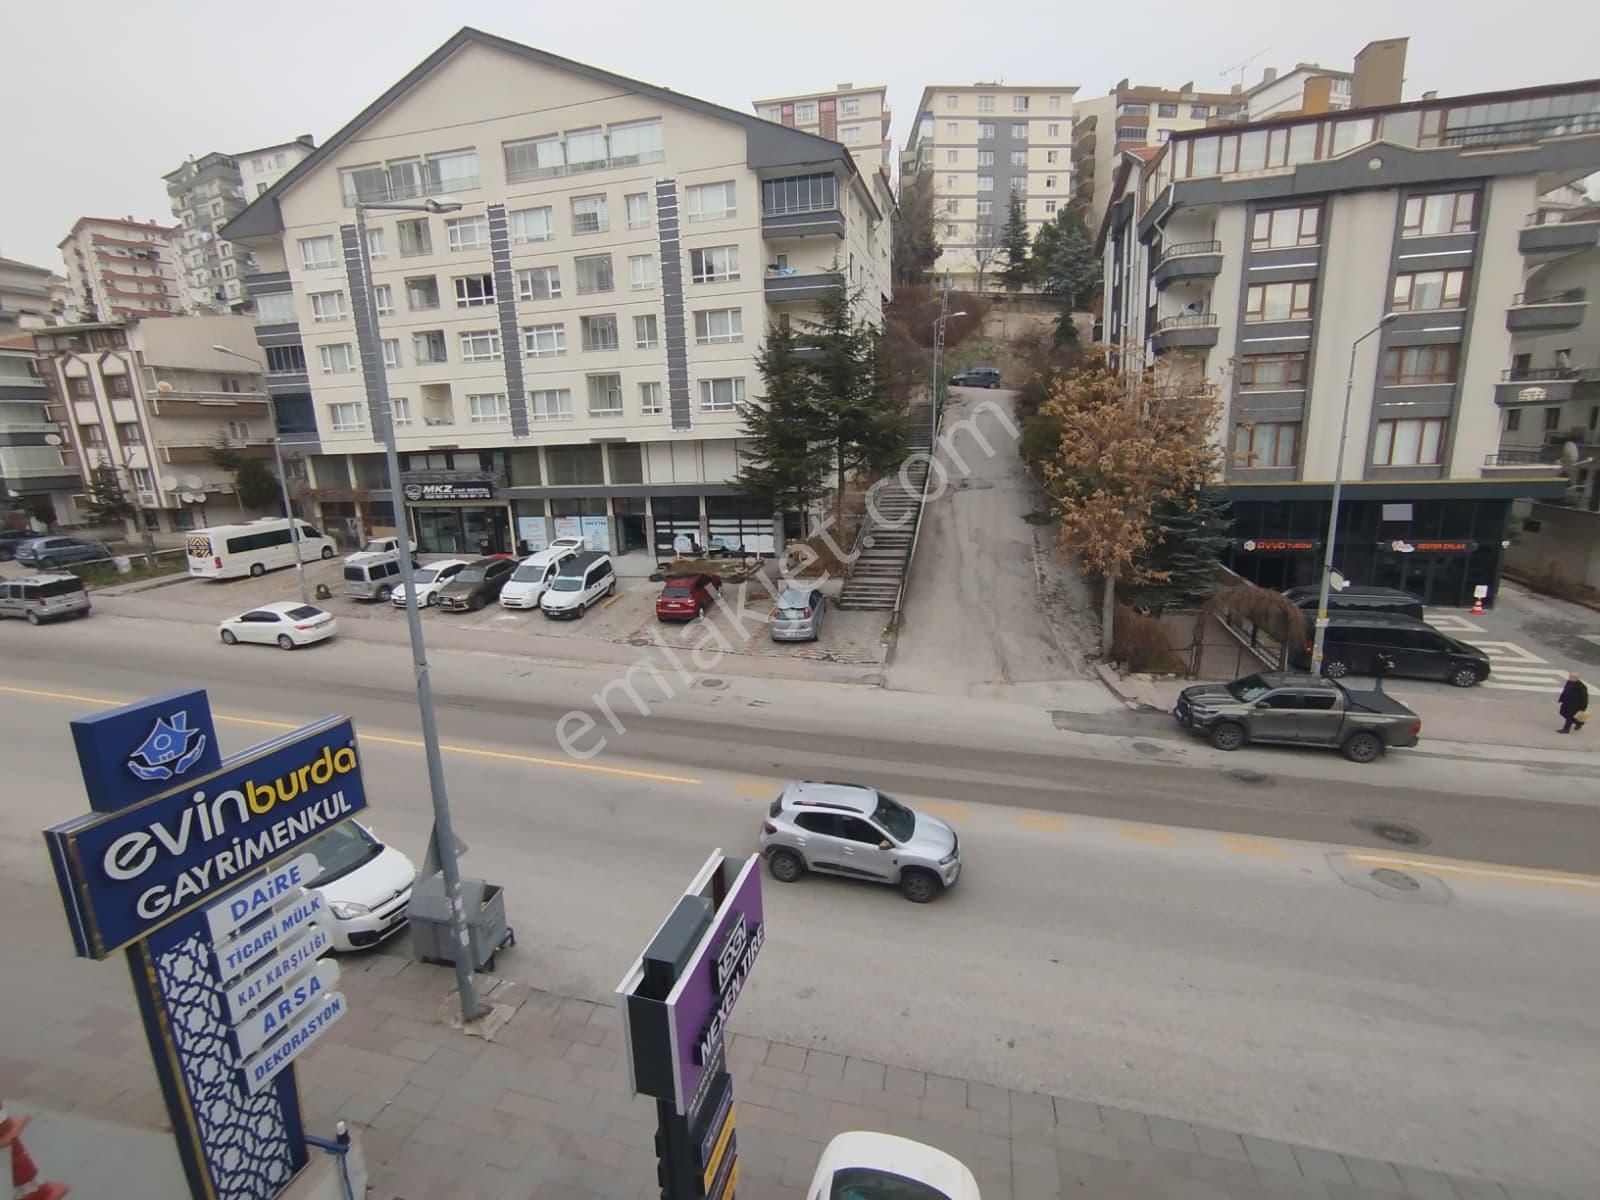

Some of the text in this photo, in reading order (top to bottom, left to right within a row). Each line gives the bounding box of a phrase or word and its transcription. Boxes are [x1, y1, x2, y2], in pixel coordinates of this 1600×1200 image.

[423, 485, 453, 493] MKZ
[137, 791, 352, 920] GAYRİMENKUL
[226, 896, 320, 970] TİCARİ MÜLK
[237, 932, 327, 1007] KAT KARŞILIĞI
[263, 975, 322, 1034] ARSA
[701, 970, 741, 1068] NEXEN
[741, 922, 763, 977] TIRE
[254, 998, 341, 1082] DEKORASYON
